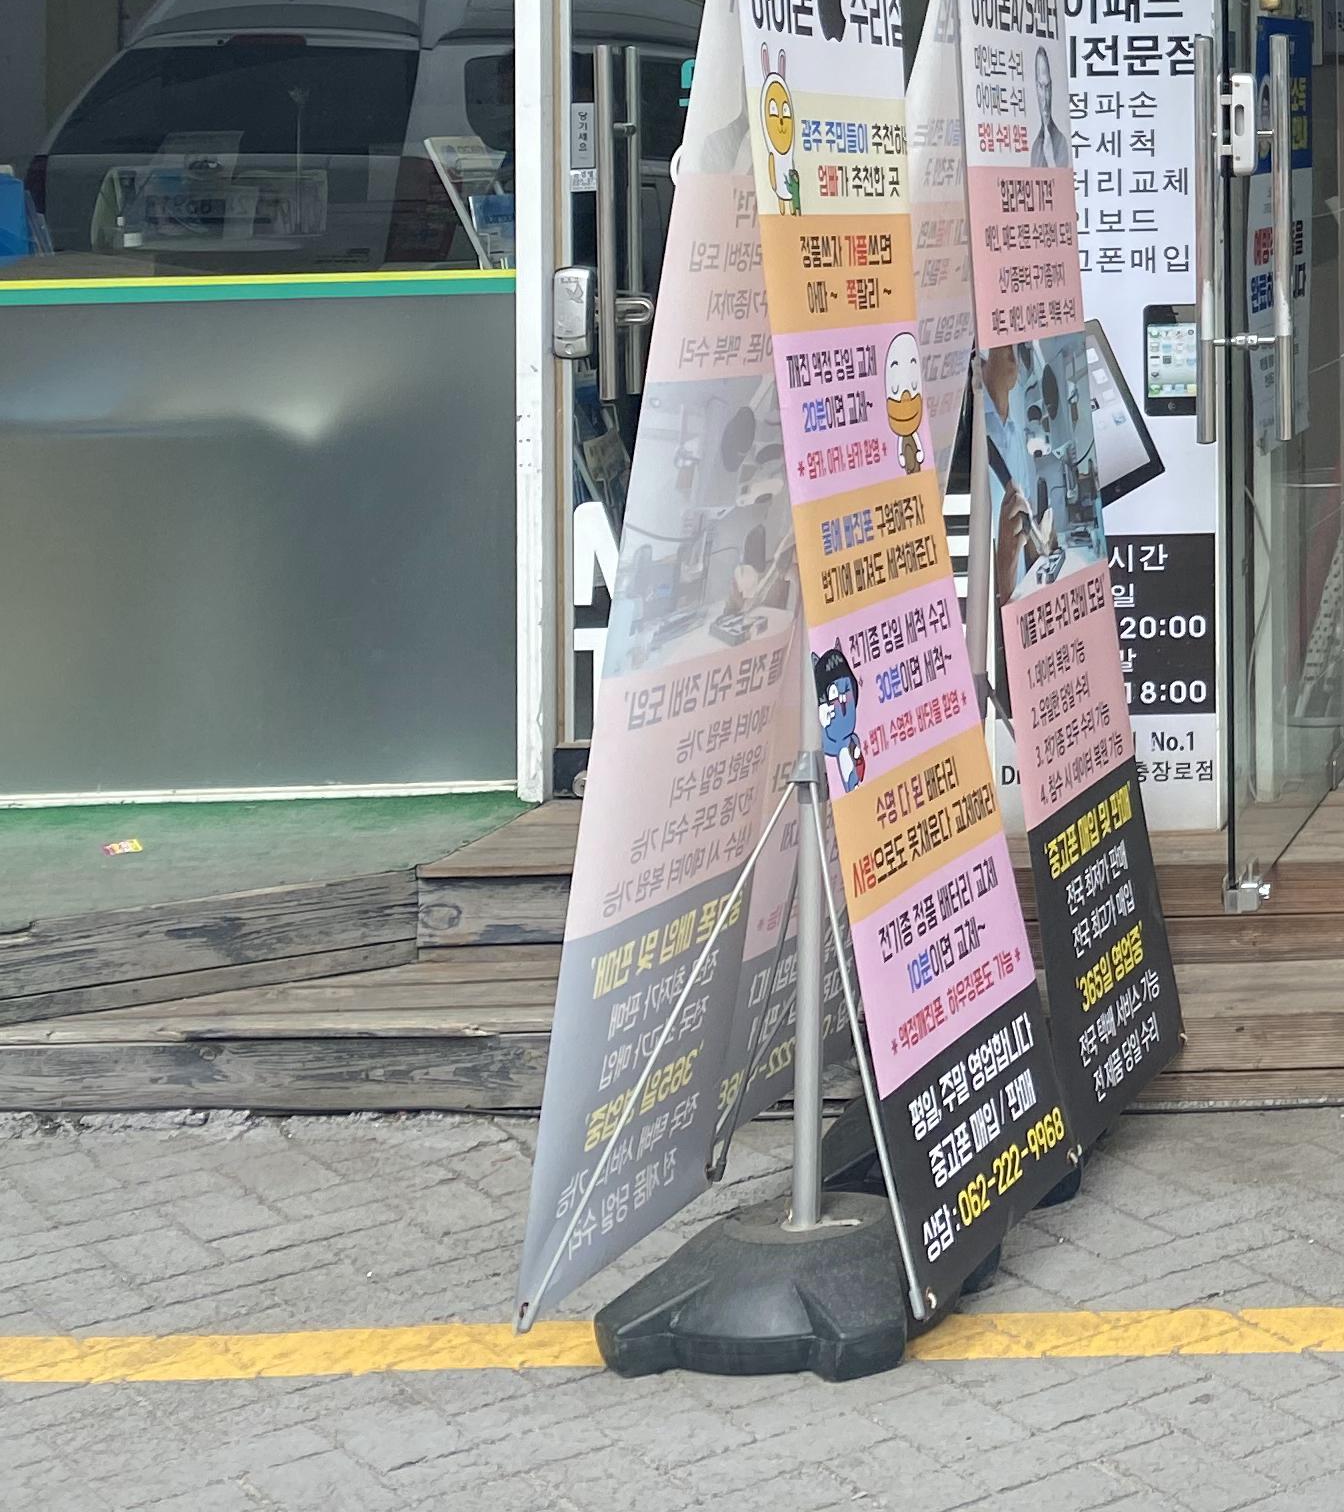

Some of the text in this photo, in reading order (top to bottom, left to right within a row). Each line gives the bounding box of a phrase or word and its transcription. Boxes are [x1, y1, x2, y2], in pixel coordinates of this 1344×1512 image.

[974, 44, 1025, 82] 메인보드 수리
[1070, 33, 1196, 79] 전문점
[976, 82, 1027, 118] 아이패드 수리
[801, 119, 869, 155] 광주 주민들이
[852, 165, 885, 197] 추천한
[888, 167, 900, 197] 곳
[800, 233, 892, 268] 정품쓰자 가품쓰면
[786, 345, 878, 389] 깨진 액정 당일 교체
[802, 393, 846, 434] 20분이면
[821, 494, 925, 556] 물에 빠진폰 구원해주자
[821, 534, 938, 605] 변기에 빠져도 세척해준다
[849, 598, 952, 670] 전기종 당일 세척 수리
[1038, 601, 1055, 640] 전문
[1055, 592, 1072, 629] 수리
[1070, 584, 1088, 621] 장비
[1120, 614, 1207, 639] 20:00
[875, 655, 923, 704] 30분이면
[1151, 731, 1195, 752] No.1
[876, 789, 898, 829] 수명
[924, 755, 960, 803] 배터리
[853, 781, 997, 899] 사랑으로도 못채운다 교체해라
[1077, 807, 1101, 857] 매입
[1098, 798, 1112, 840] 및
[1065, 839, 1129, 917] 전국 최저가 판매
[878, 855, 999, 964] 전기종 정품 배터리 교체
[1071, 879, 1136, 959] 전국 최고가 매입
[907, 932, 955, 994] 10분이면
[993, 949, 1014, 979] 가능
[1079, 968, 1160, 1068] 전국 택배 서비스 가능
[1122, 1028, 1142, 1072] 당일
[1141, 1011, 1160, 1052] 수리
[908, 1011, 1034, 1141] 평일, 주말 영업합니다
[928, 1068, 1037, 1189] 중고폰 매입 판매
[957, 1106, 1065, 1227] 062-222-9968
